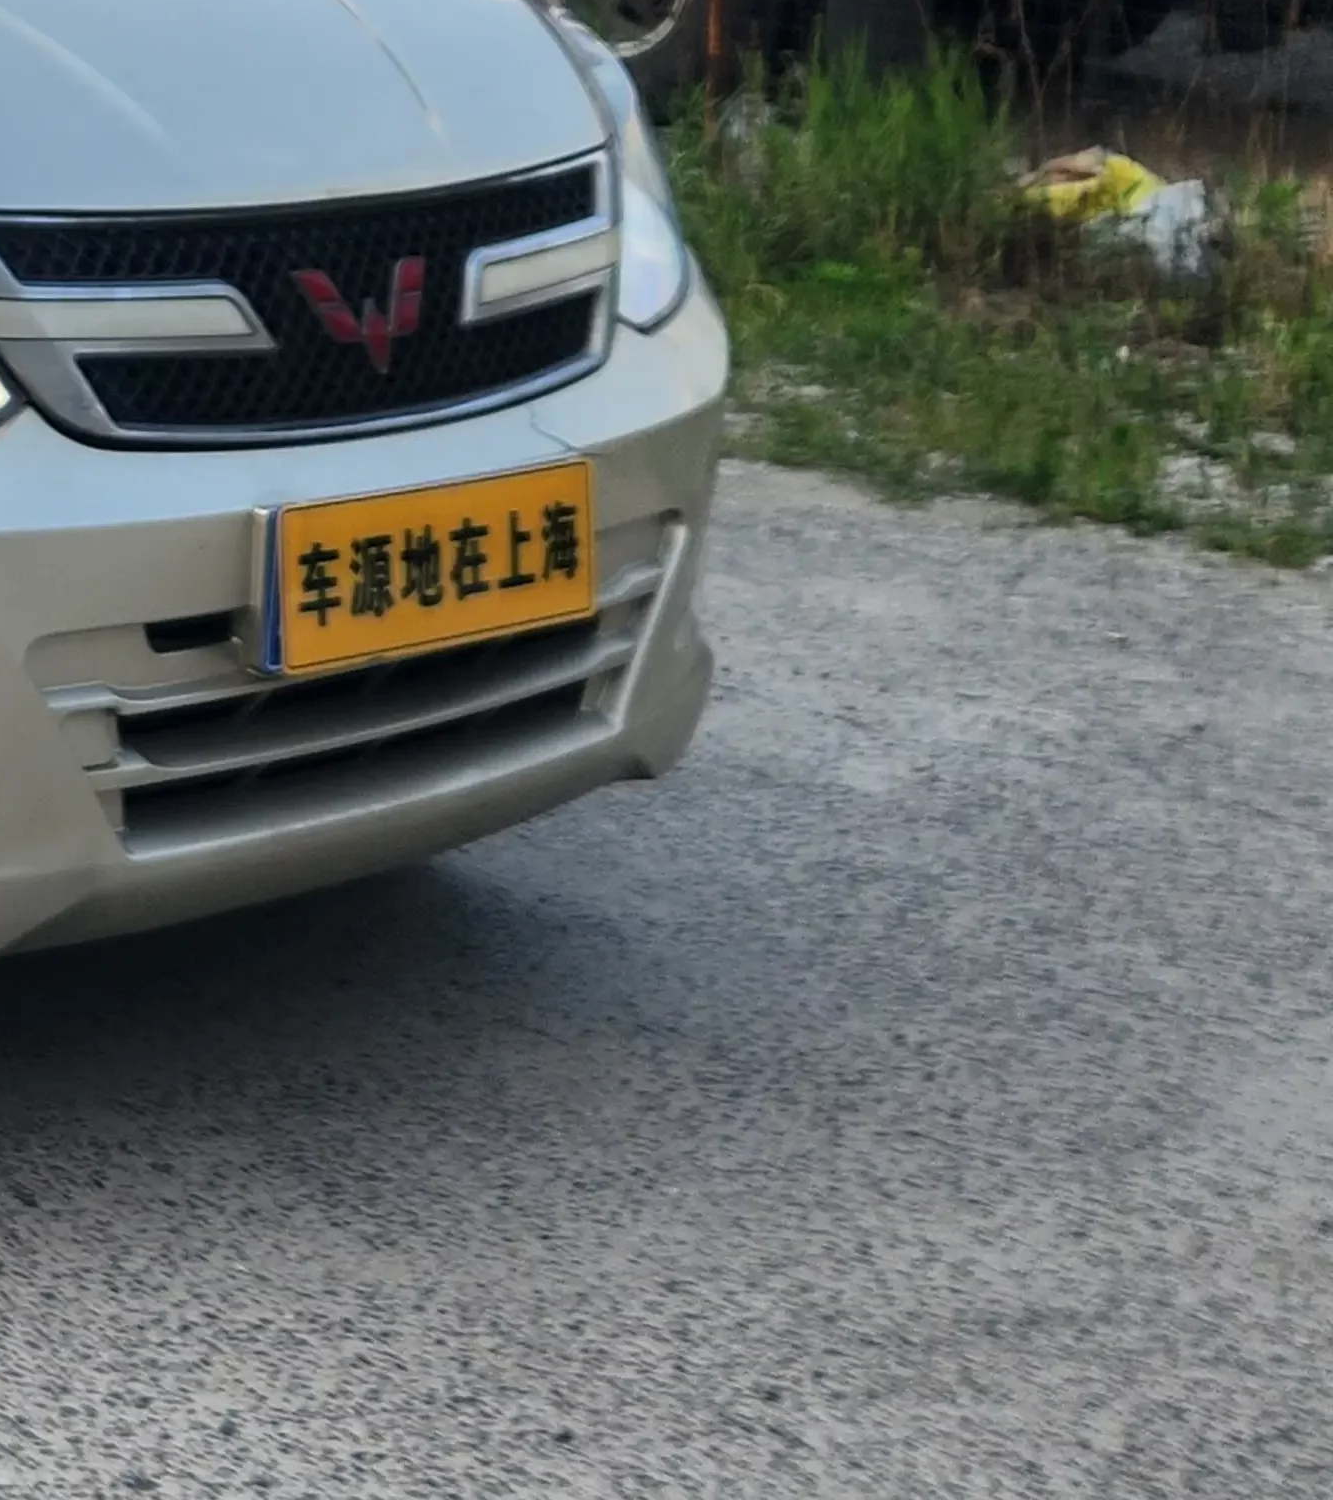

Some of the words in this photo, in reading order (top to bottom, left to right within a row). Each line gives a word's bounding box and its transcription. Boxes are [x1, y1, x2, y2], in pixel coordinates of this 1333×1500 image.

[297, 501, 579, 627] 车源地在上海
